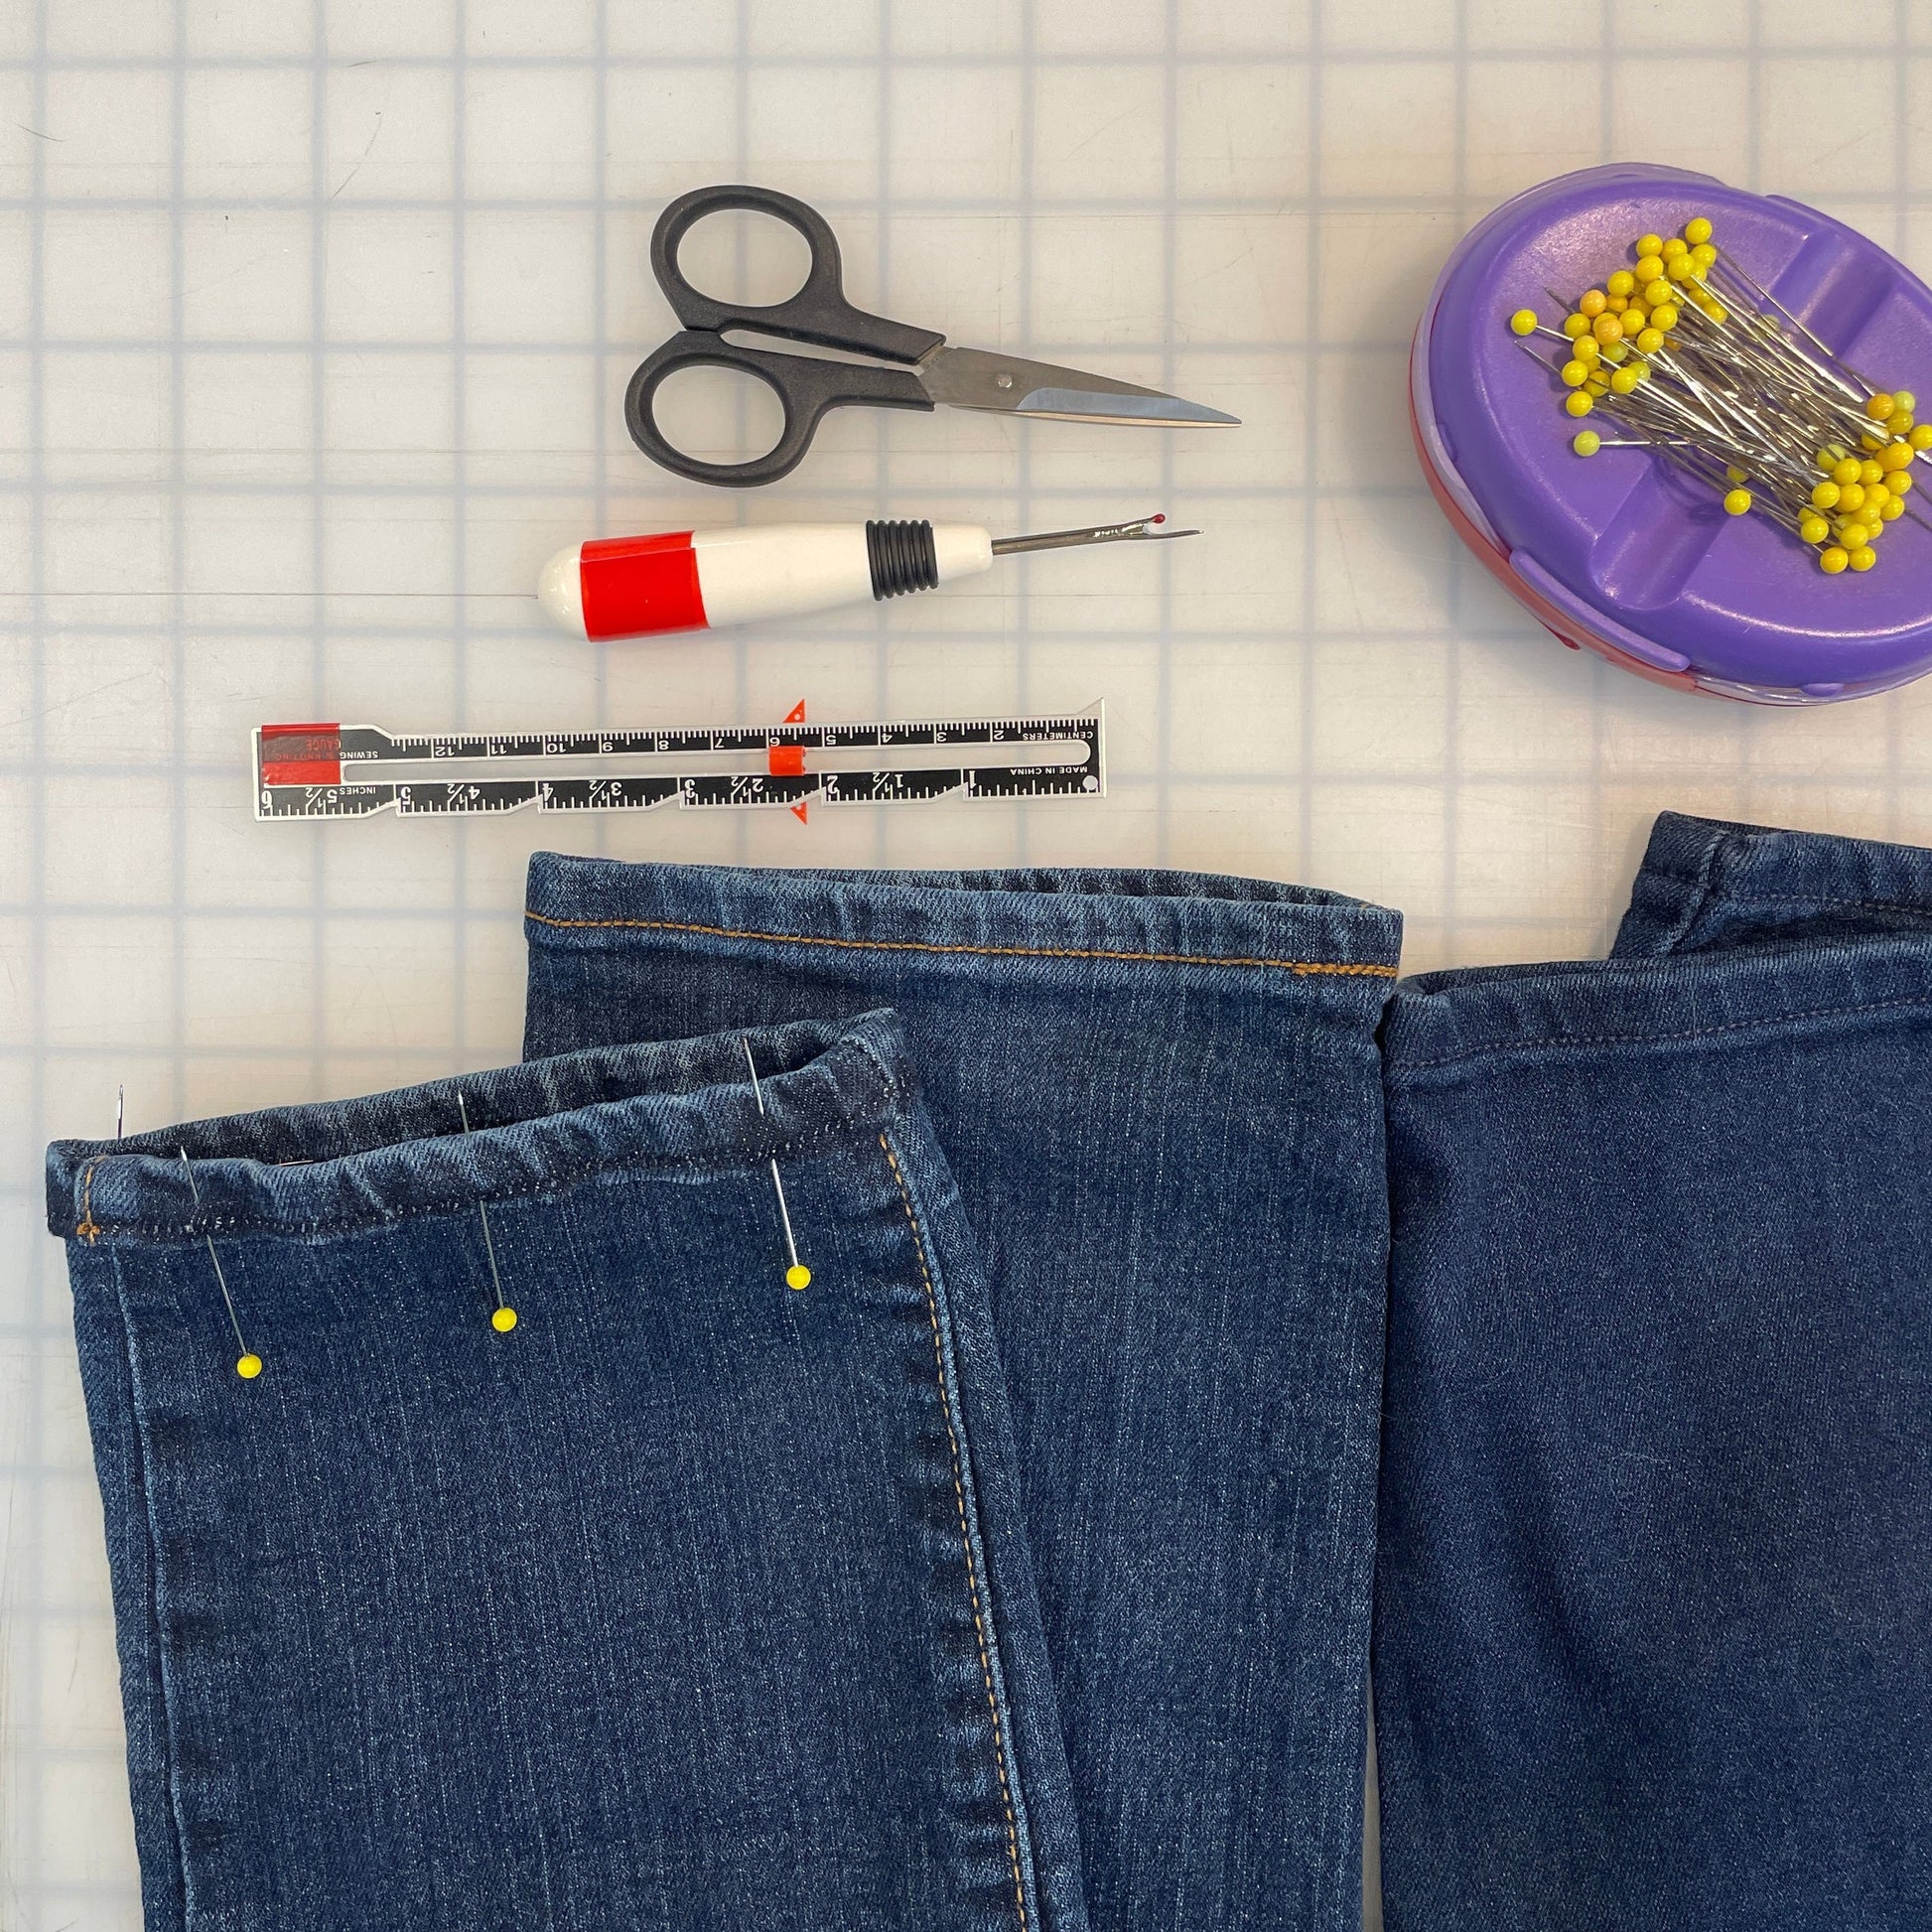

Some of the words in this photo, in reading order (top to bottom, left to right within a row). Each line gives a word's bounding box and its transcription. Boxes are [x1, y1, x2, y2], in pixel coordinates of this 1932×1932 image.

[826, 735, 837, 745] 5
[882, 733, 893, 744] 4
[936, 732, 947, 743] 3
[993, 730, 1005, 741] 2
[1023, 731, 1094, 741] CENTIMETERS
[306, 739, 342, 752] GAUGE
[602, 742, 614, 753] 9
[658, 740, 669, 751] 8
[715, 738, 725, 749] 7
[769, 737, 780, 748] 6
[435, 746, 455, 757] 12
[490, 744, 507, 755] 11
[546, 743, 566, 754] 10
[1010, 766, 1042, 775] CHINA
[1058, 765, 1088, 774] MADE
[827, 774, 839, 794] 2
[968, 769, 977, 789] 1
[339, 786, 376, 795] INCHES
[543, 782, 554, 802] 4
[684, 778, 695, 798] 3
[261, 790, 273, 809] 6
[400, 786, 412, 806] 5
